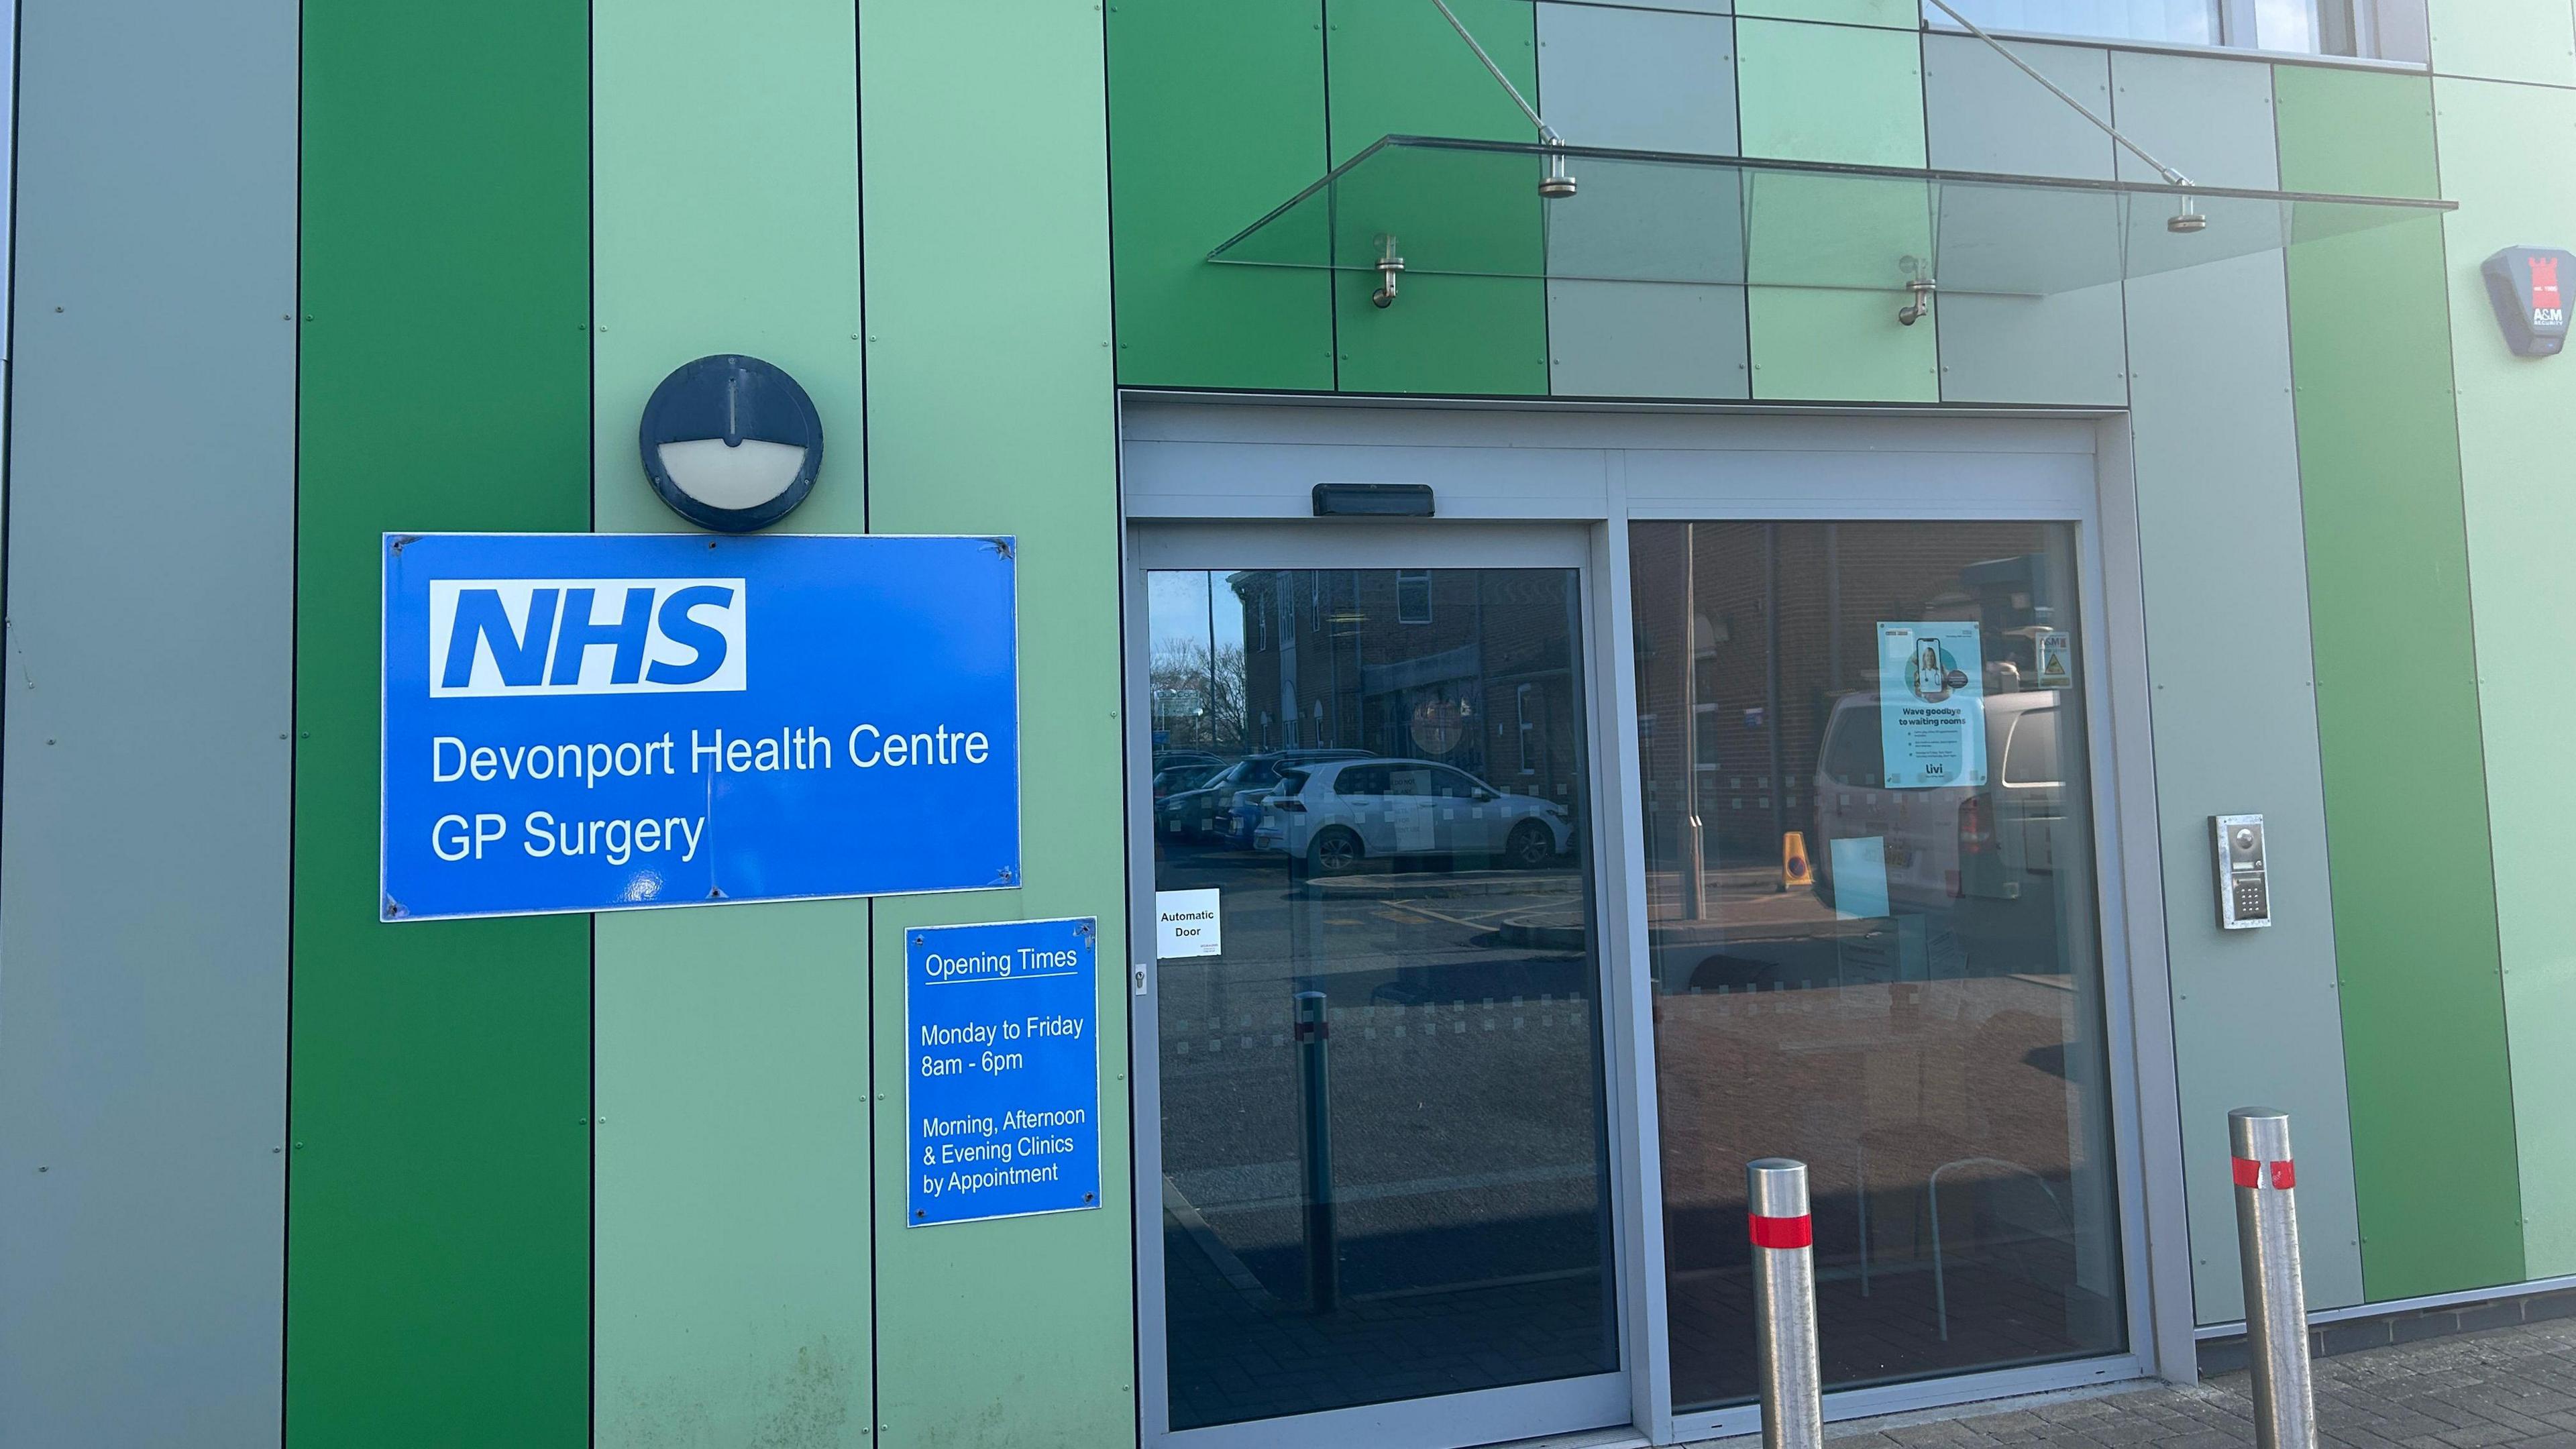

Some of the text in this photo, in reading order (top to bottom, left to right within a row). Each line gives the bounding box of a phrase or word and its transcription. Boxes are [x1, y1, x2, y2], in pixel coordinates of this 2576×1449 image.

[2534, 308, 2563, 321] A&M
[441, 585, 735, 688] NHS
[1908, 716, 1939, 727] waiting
[1925, 708, 1962, 717] goodbye
[433, 724, 989, 789] Devonport Health Centre
[432, 811, 705, 865] GP Surgery
[1161, 910, 1214, 922] Automatic
[1175, 928, 1201, 936] Door
[926, 948, 1077, 981] Opening Times
[922, 1015, 1084, 1046] Monday to Friday
[922, 1055, 962, 1077] 8am
[981, 1051, 1023, 1076] 6pm
[923, 1109, 1085, 1138] Morning, Afternoon
[923, 1134, 1074, 1165] & Evening Clinics
[923, 1163, 1059, 1197] by Appointment
